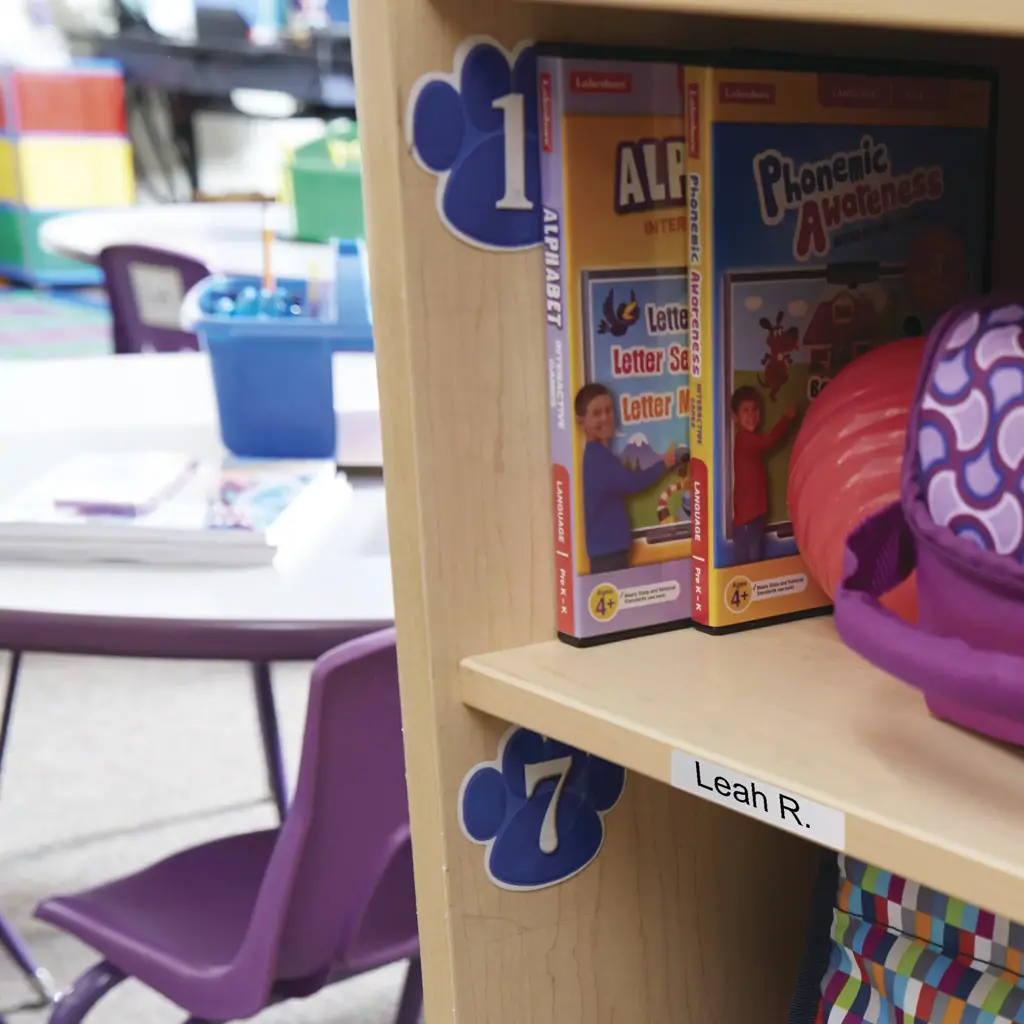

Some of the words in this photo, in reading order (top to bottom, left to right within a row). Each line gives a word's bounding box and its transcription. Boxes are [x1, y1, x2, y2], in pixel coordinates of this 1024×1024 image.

[492, 92, 535, 211] 1
[756, 136, 889, 221] Phonemic
[689, 174, 700, 264] Phonemic
[795, 167, 945, 259] Awareness
[542, 206, 563, 330] ALPHABET
[612, 347, 664, 376] Letter
[690, 270, 701, 377] Awareness
[620, 392, 673, 423] Letter
[556, 480, 565, 544] LANGUAGE
[693, 481, 701, 542] LANGUAGE
[523, 755, 573, 855] 7
[694, 760, 769, 813] Leah
[779, 793, 811, 829] R.
